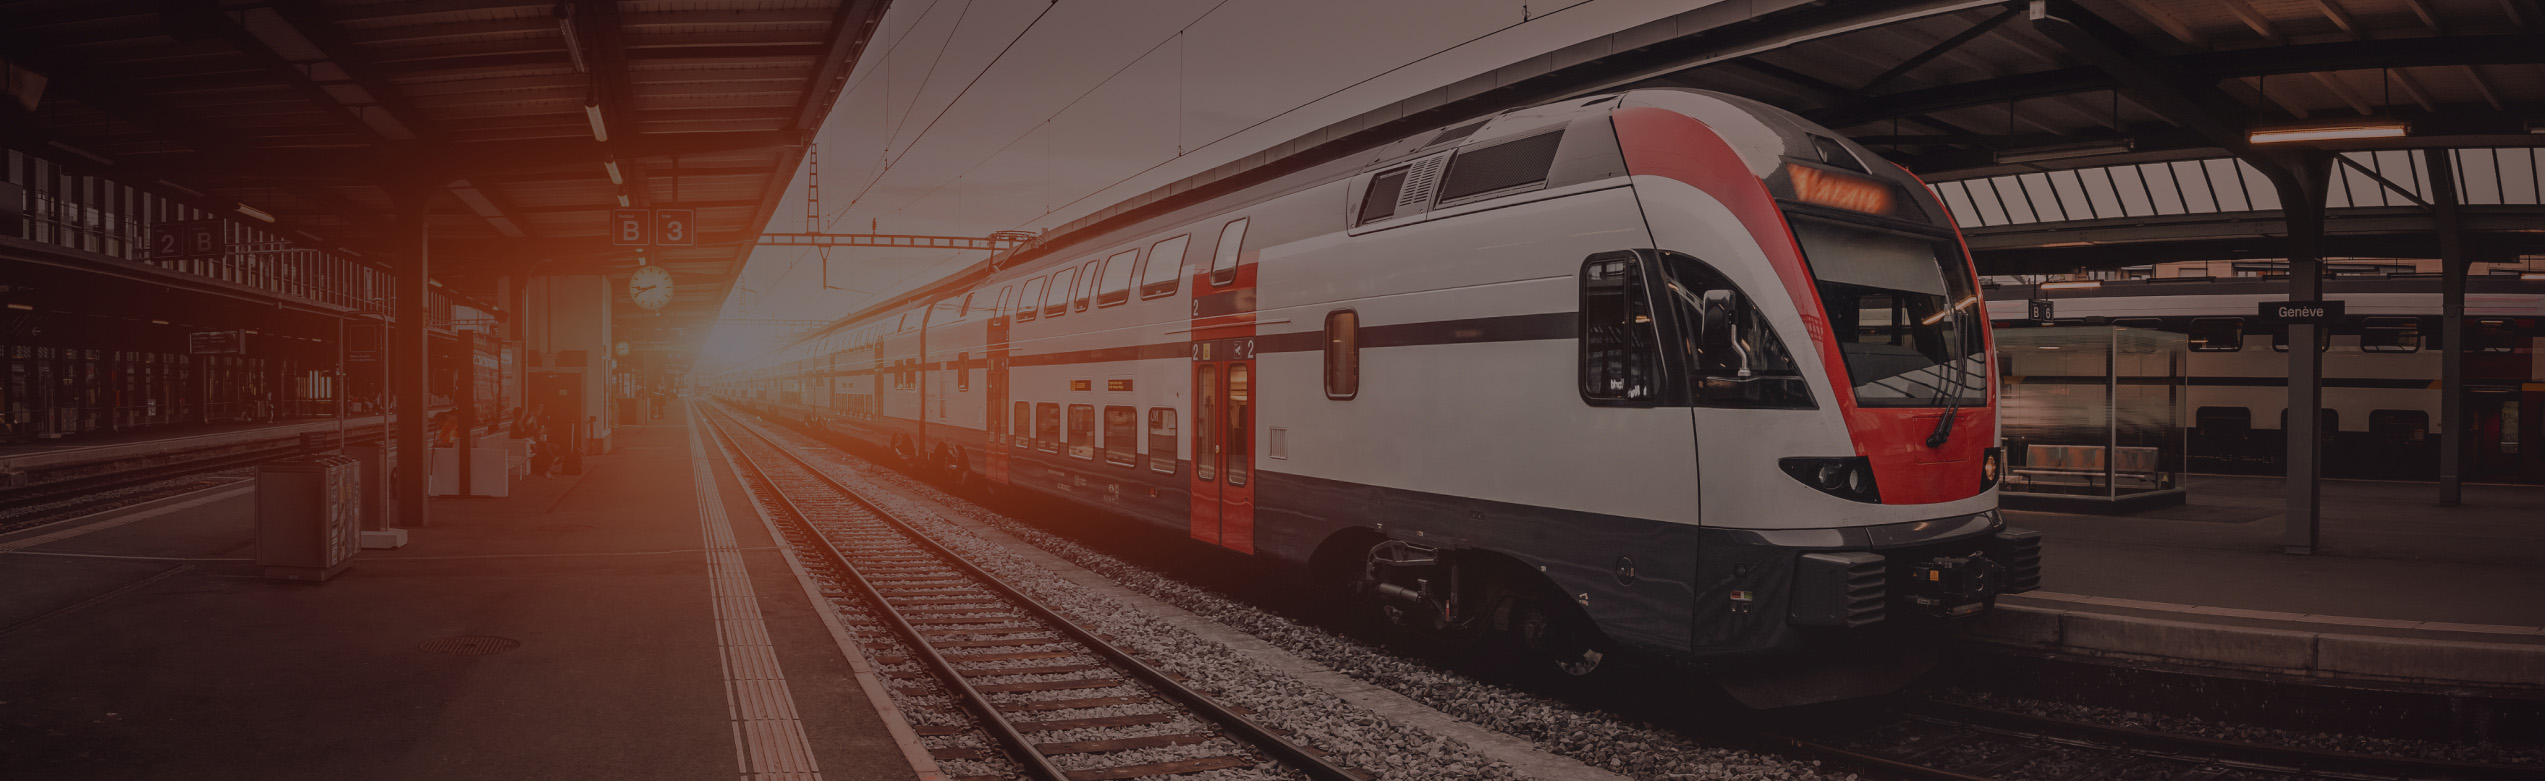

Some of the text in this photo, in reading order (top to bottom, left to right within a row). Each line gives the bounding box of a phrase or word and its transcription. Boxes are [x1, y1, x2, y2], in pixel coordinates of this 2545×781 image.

[623, 221, 640, 241] B
[666, 220, 683, 241] 3
[161, 234, 175, 254] 2
[197, 232, 212, 252] B
[1193, 299, 1199, 316] 2
[2033, 306, 2039, 318] B
[2045, 307, 2051, 319] 6
[2278, 305, 2324, 318] Genève
[1192, 344, 1199, 361] 2
[1247, 339, 1254, 359] 2
